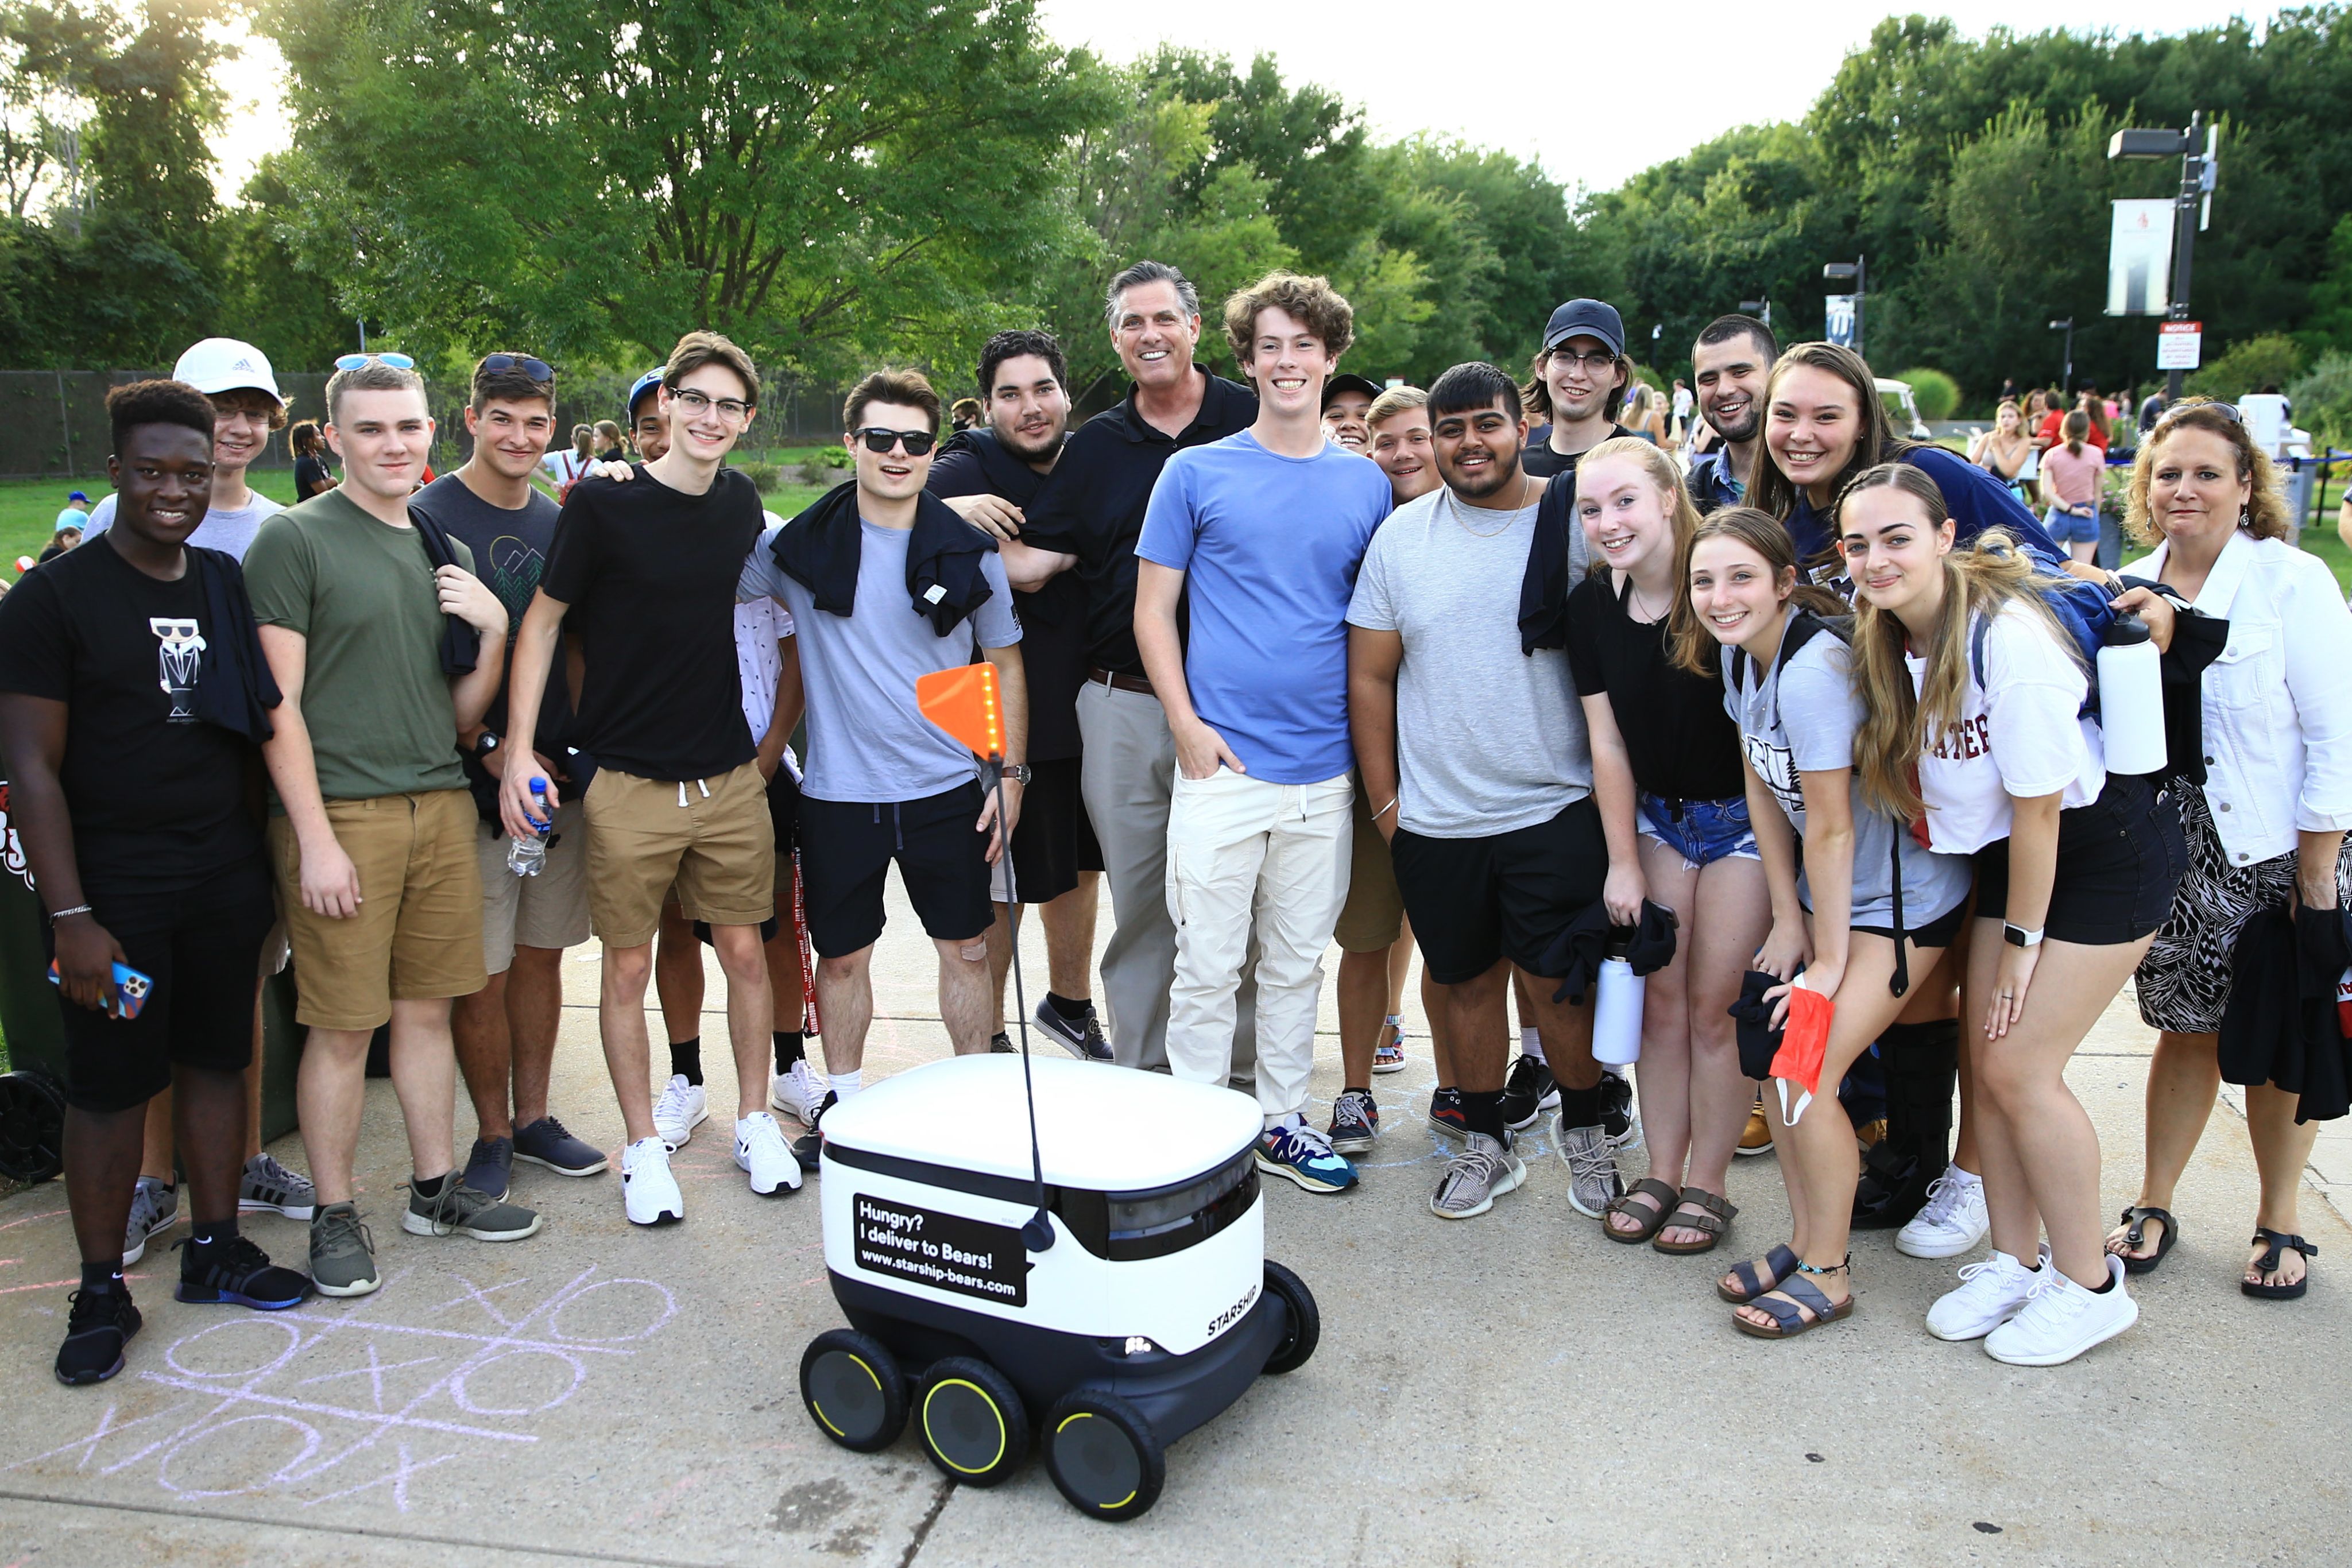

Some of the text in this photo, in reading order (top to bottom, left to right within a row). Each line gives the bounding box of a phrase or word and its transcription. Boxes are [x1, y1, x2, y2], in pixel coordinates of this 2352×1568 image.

[2164, 323, 2196, 332] NOTICE
[860, 1201, 924, 1233] Hungry?
[860, 1223, 993, 1269] I deliver to Bears!
[861, 1249, 1016, 1296] www.starship-bears.com
[1208, 1284, 1256, 1336] STARSHIP
